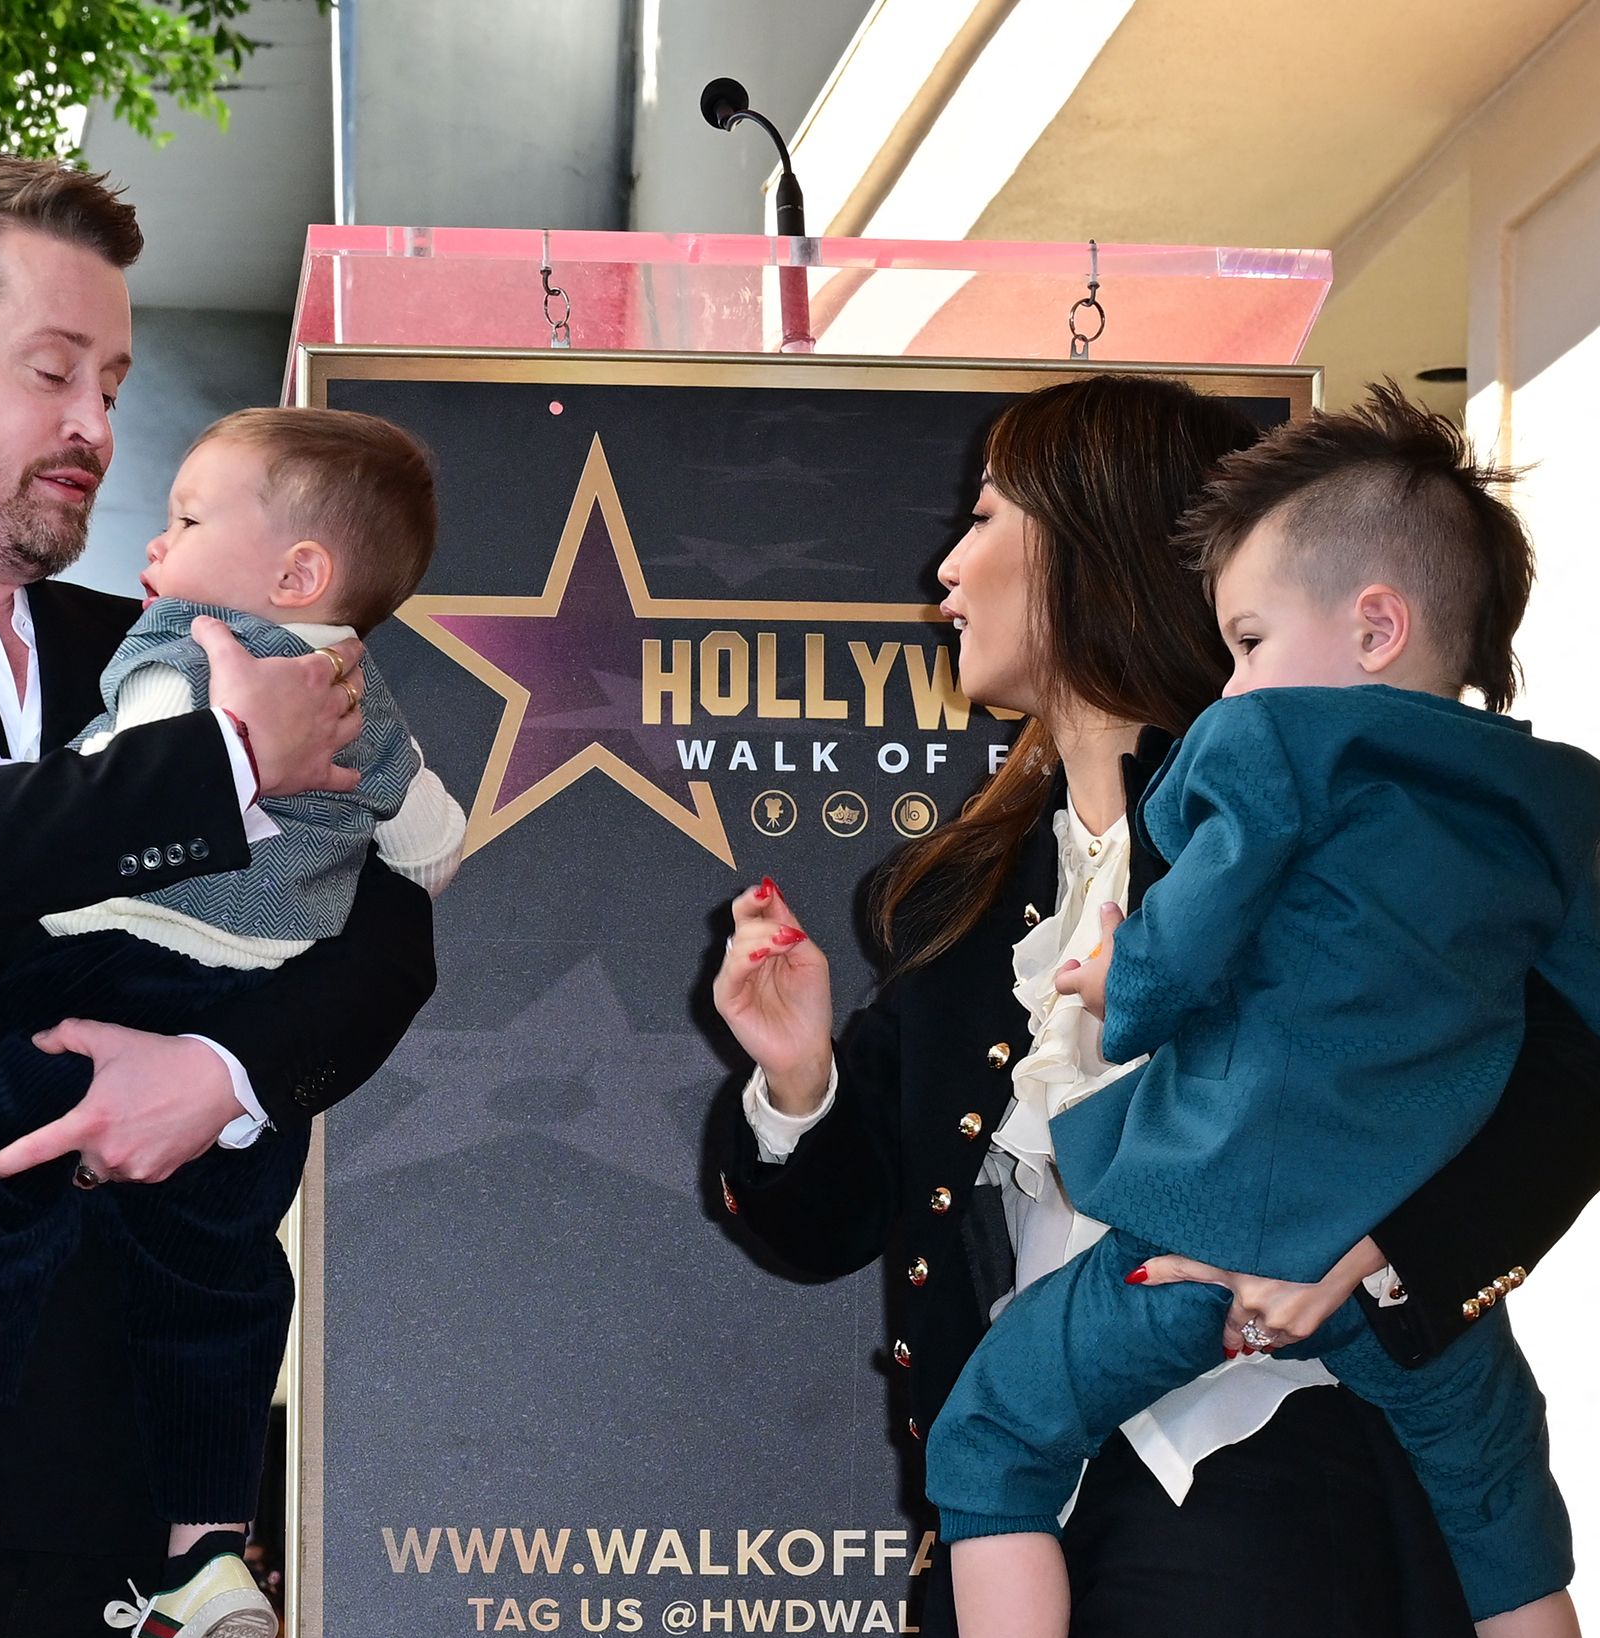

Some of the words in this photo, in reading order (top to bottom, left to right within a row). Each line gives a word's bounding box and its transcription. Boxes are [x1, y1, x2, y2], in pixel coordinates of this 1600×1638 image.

[642, 630, 1022, 731] HOLLYW
[676, 739, 840, 773] WALK
[877, 742, 948, 774] OF
[382, 1526, 936, 1577] WWW.WALKOFFA
[467, 1597, 561, 1633] TAG
[579, 1597, 644, 1634] US
[661, 1598, 920, 1636] @HWDWAL
